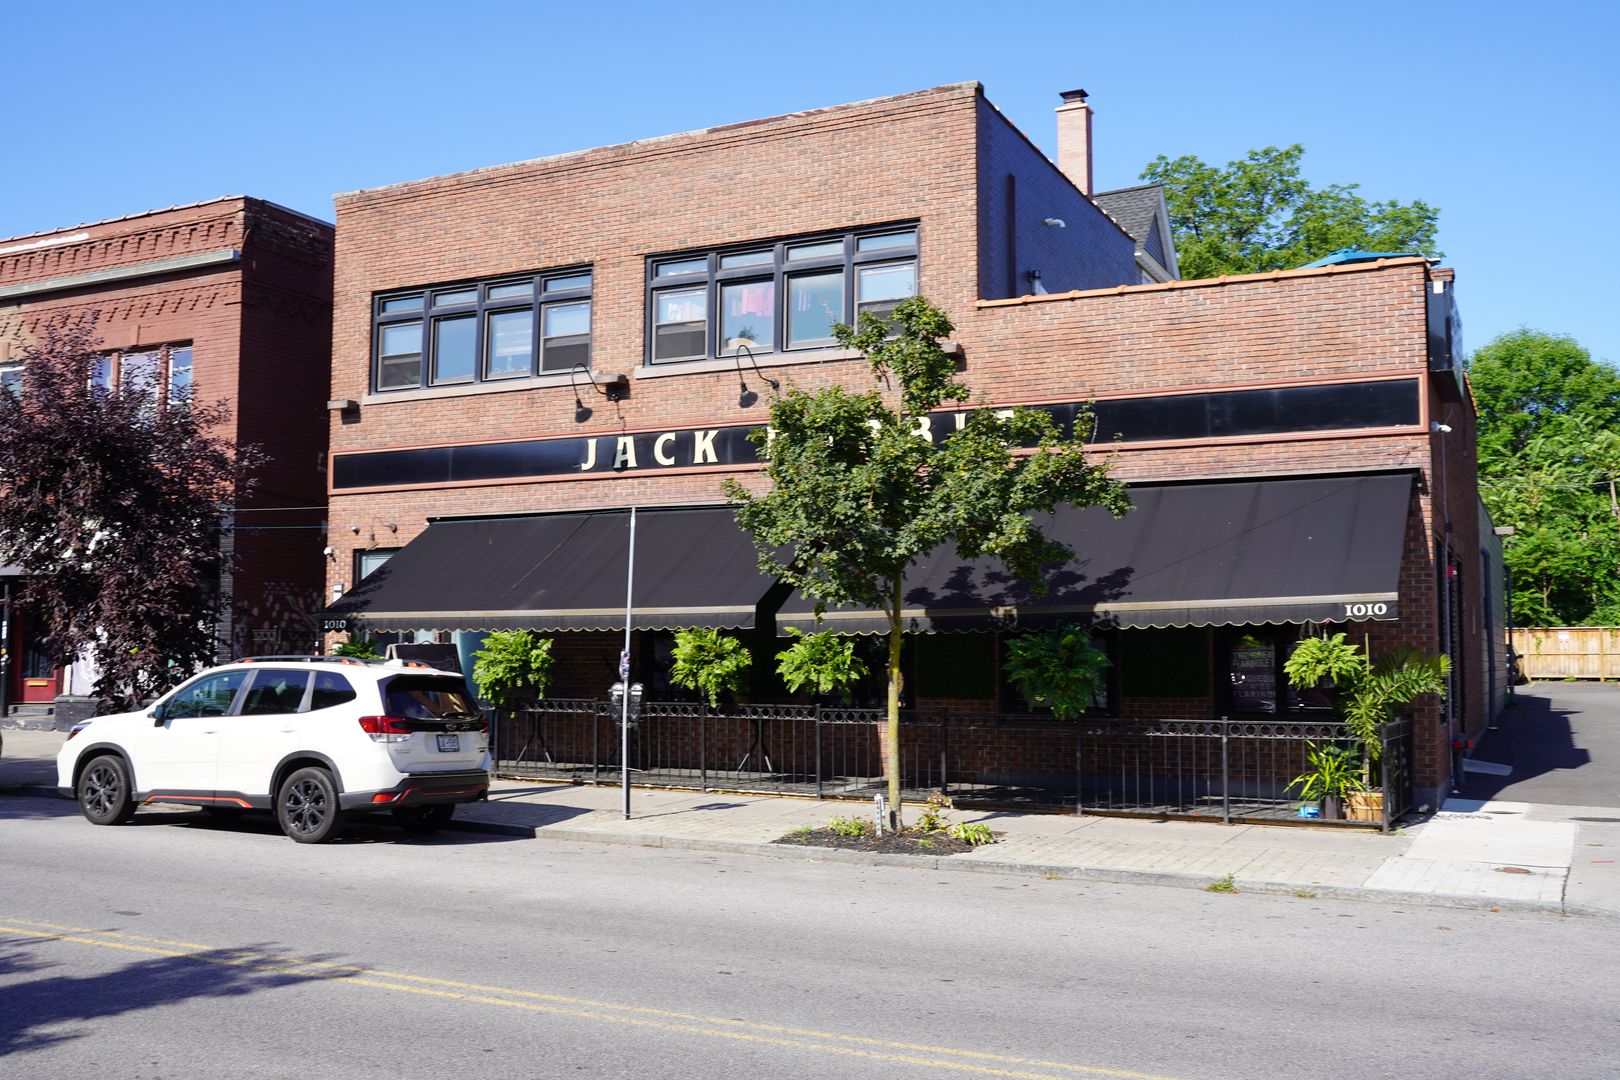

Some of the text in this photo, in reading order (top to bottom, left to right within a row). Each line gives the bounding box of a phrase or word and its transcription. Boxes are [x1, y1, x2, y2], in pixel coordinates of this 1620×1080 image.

[581, 430, 719, 471] JACK
[1345, 603, 1387, 616] 1010
[323, 620, 347, 629] 1010
